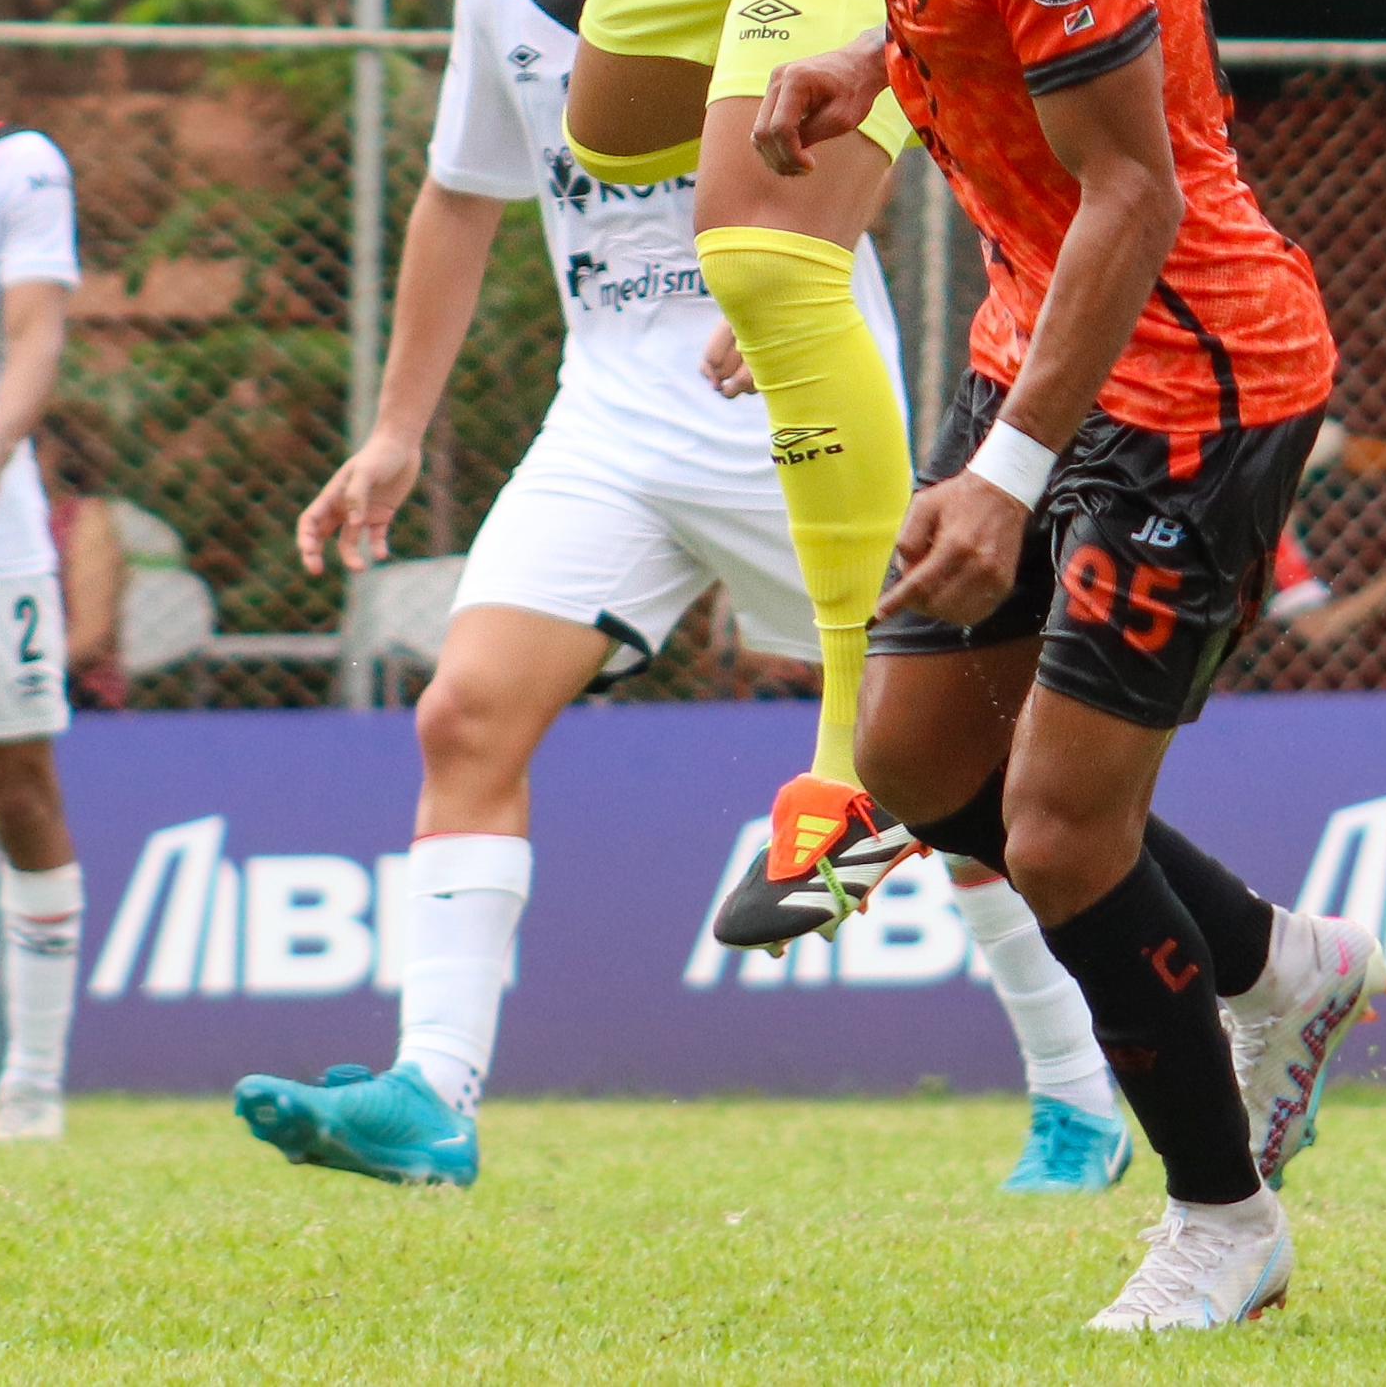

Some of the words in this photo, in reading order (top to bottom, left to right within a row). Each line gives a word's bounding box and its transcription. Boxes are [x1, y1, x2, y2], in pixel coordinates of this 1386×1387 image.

[739, 25, 790, 41] umbro
[601, 262, 710, 313] medism
[14, 596, 43, 665] 2
